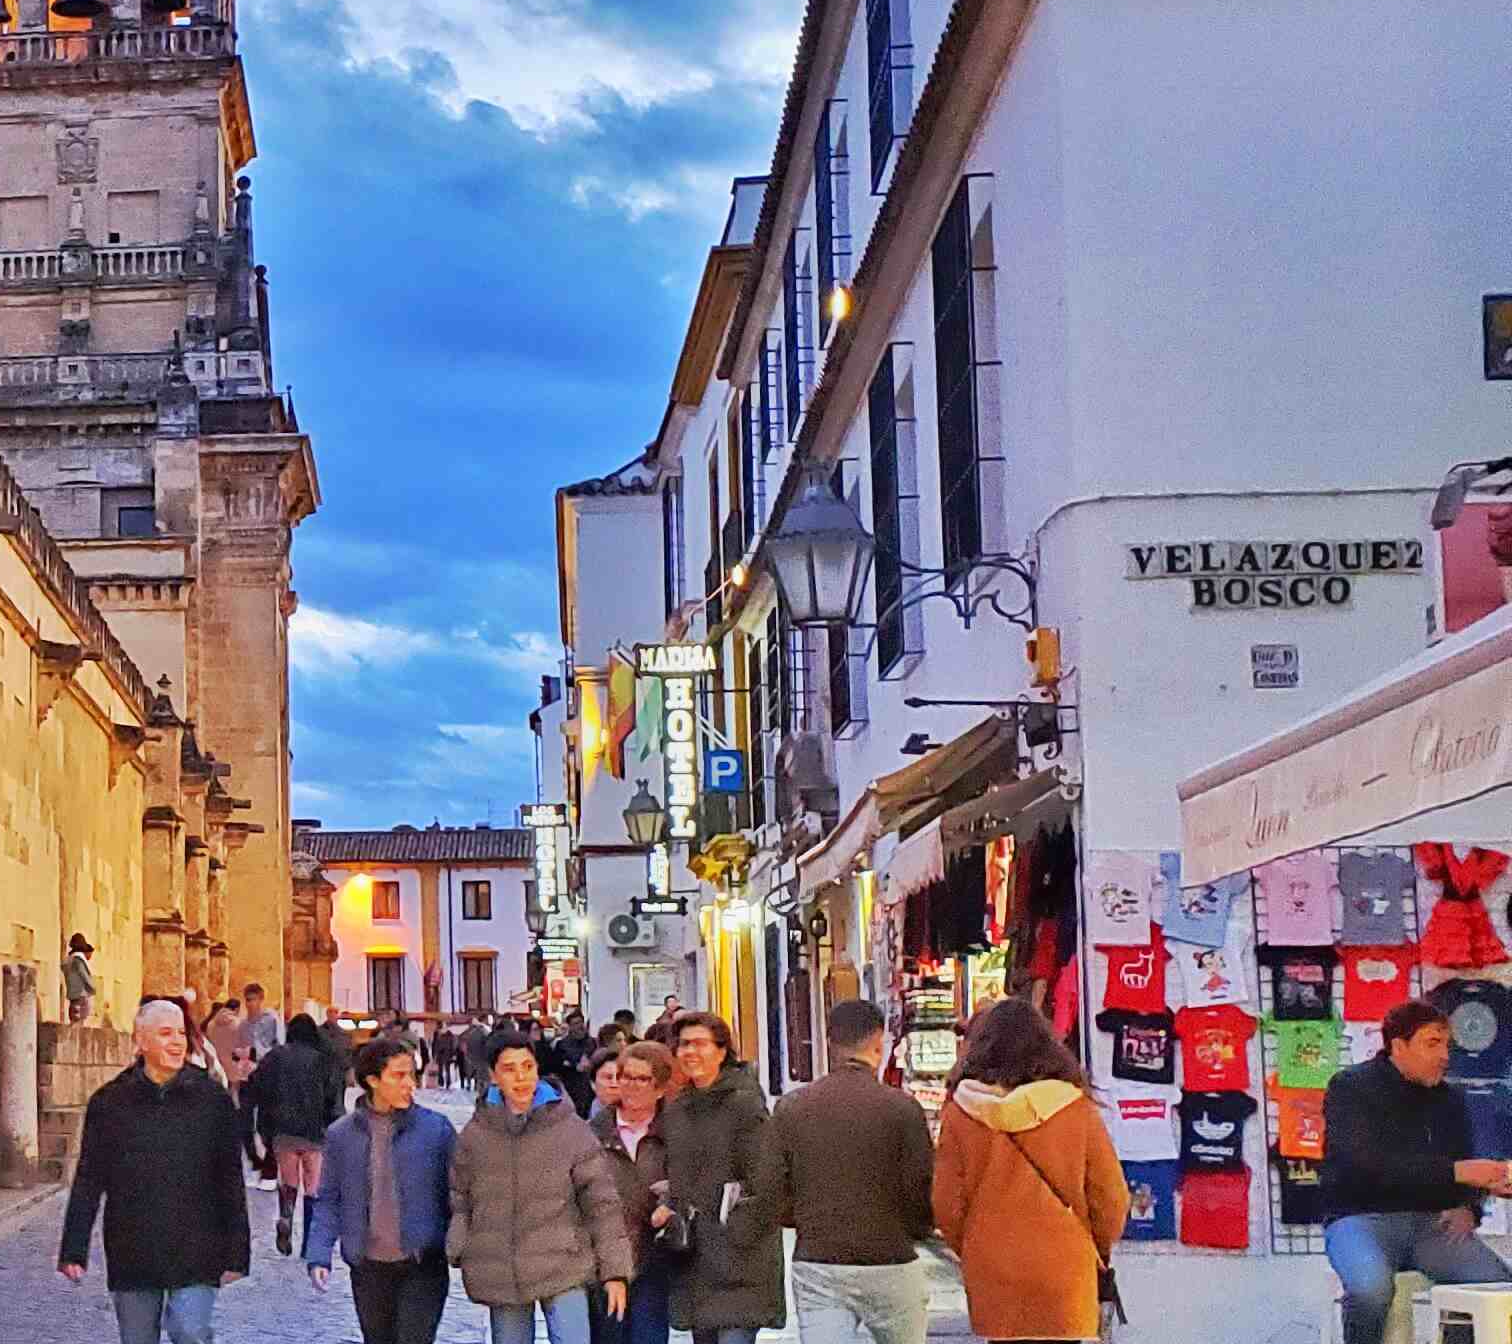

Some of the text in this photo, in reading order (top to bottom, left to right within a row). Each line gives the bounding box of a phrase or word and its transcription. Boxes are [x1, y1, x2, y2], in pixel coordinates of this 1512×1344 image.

[1129, 541, 1424, 574] VELAZQUEZ
[1192, 576, 1352, 607] BOSCO
[664, 677, 697, 838] HOTEL
[710, 755, 738, 788] P
